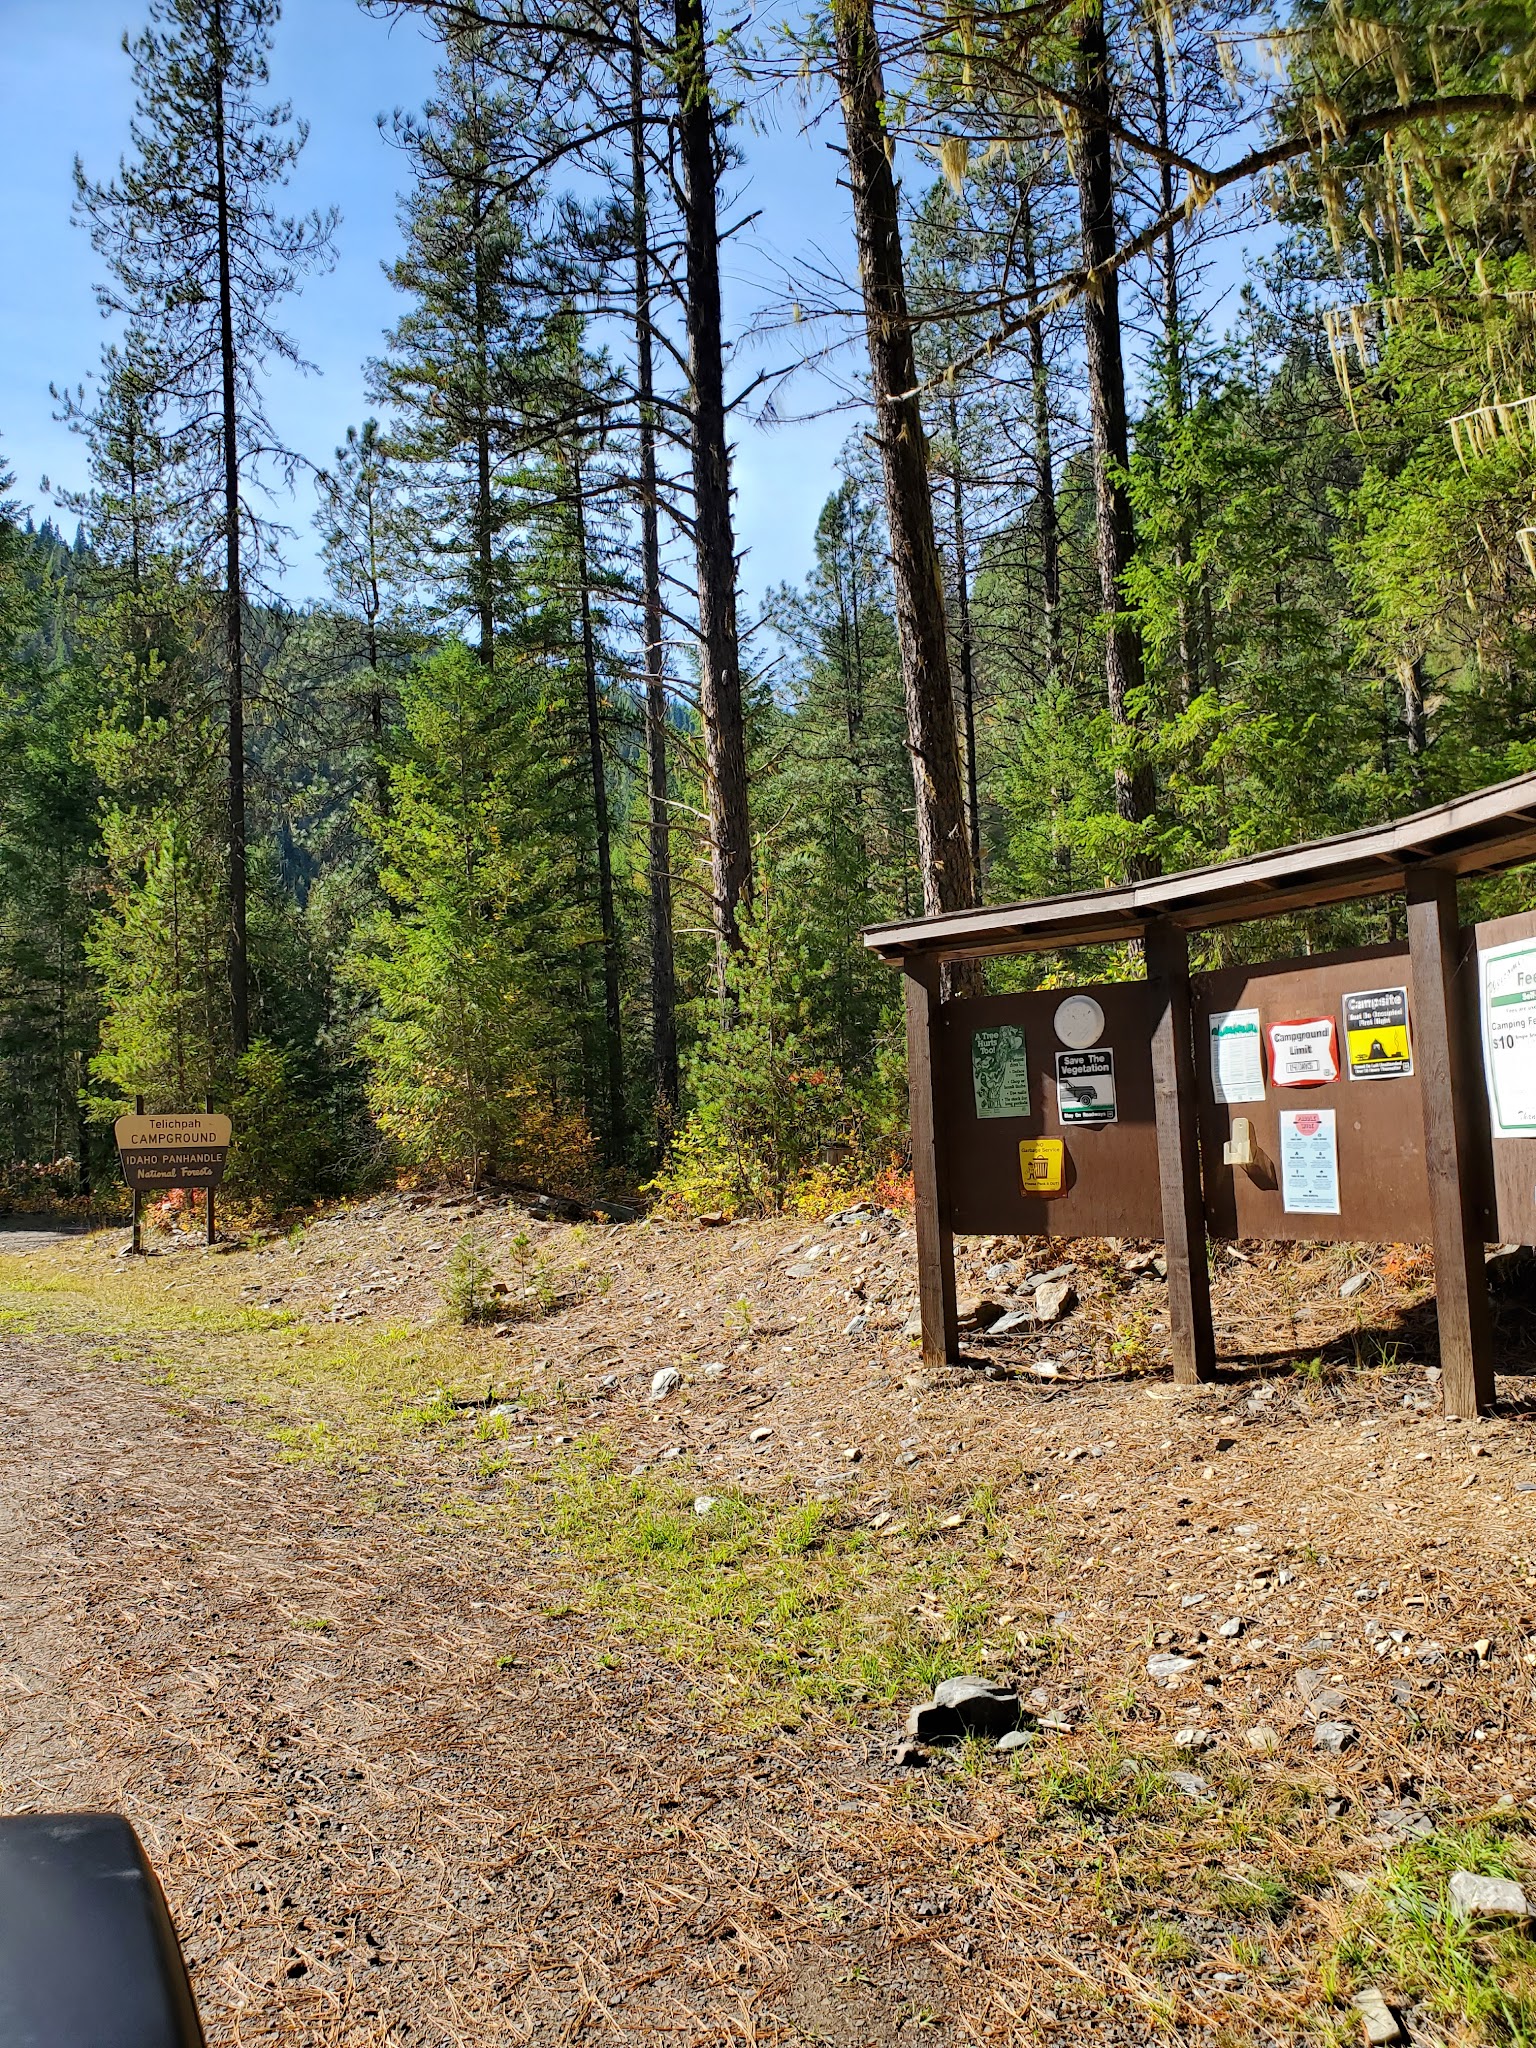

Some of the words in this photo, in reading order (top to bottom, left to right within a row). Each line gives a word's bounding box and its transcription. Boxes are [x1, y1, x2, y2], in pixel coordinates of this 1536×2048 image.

[1347, 993, 1402, 1010] Campsite
[1491, 1019, 1526, 1031] Camping
[982, 1032, 999, 1040] Tree
[1273, 1027, 1330, 1043] Campground
[977, 1039, 998, 1048] Hurts
[1493, 1034, 1515, 1050] $10
[980, 1047, 996, 1055] Too!
[1289, 1044, 1313, 1055] Limit
[1063, 1056, 1085, 1065] Save
[1087, 1054, 1105, 1063] The
[1061, 1064, 1110, 1075] Vegetation
[149, 1119, 201, 1130] Telichpah
[131, 1132, 217, 1144] CAMPGROUND
[126, 1155, 158, 1165] IDAHO
[162, 1153, 223, 1164] PANHANDLE
[137, 1167, 177, 1179] National
[180, 1166, 213, 1177] Forests
